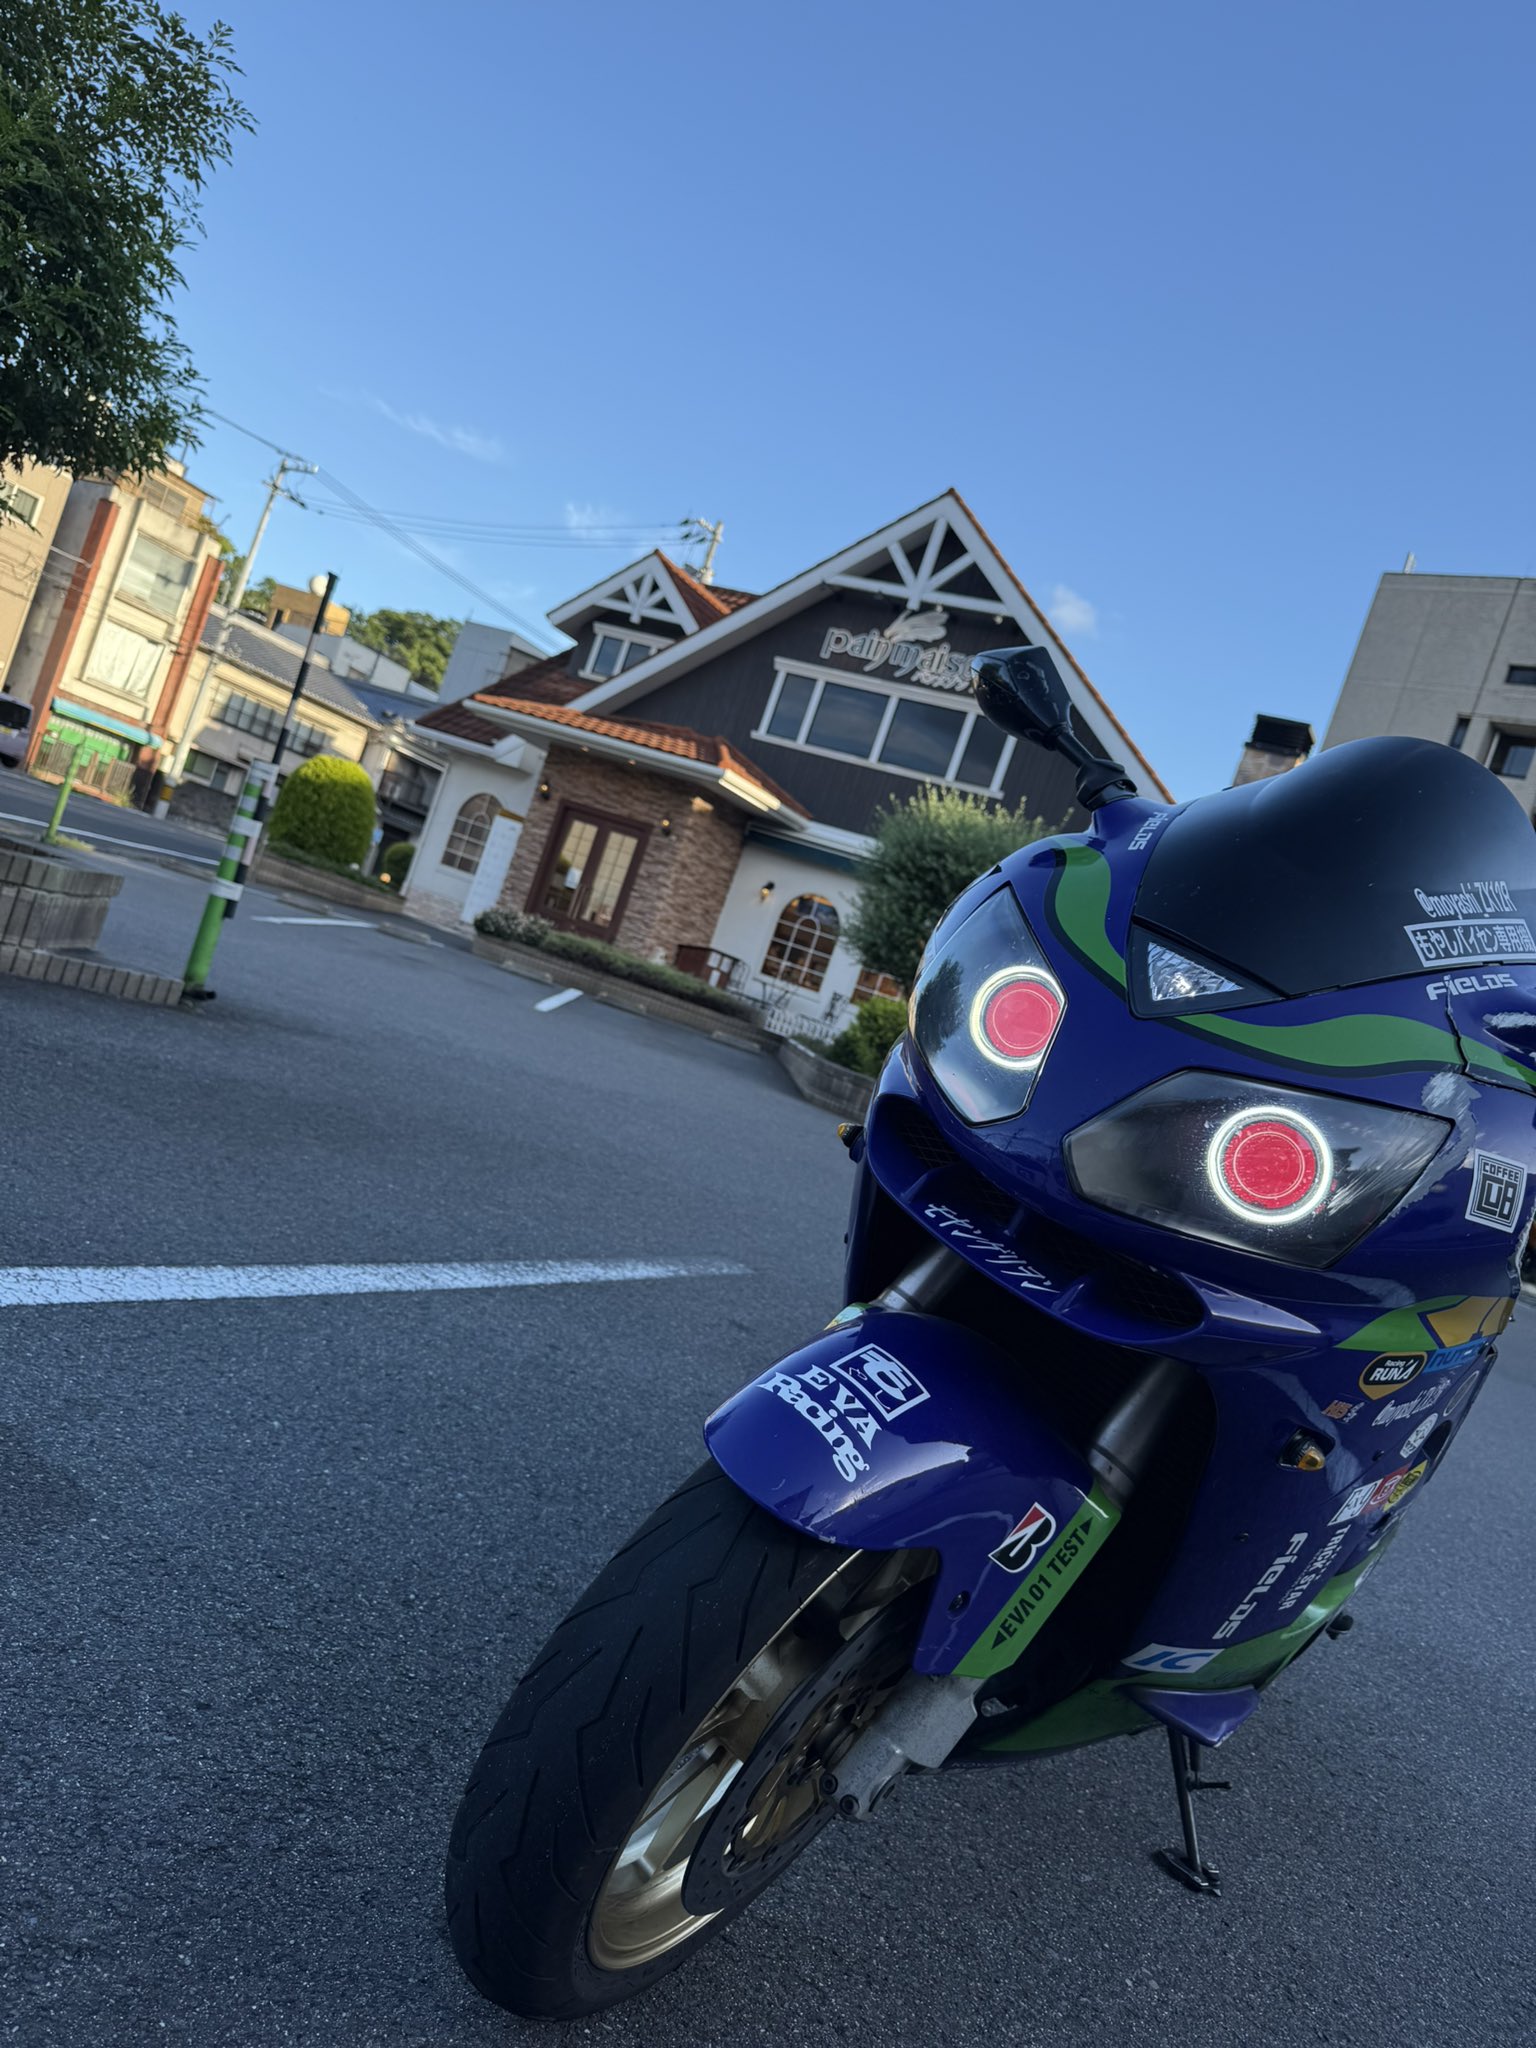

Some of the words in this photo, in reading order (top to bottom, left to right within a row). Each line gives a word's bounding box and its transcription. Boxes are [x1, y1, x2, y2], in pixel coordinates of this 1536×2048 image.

[1415, 925, 1536, 959] もやしパイセン専用機
[1482, 1161, 1520, 1183] COFFEE
[1384, 1359, 1407, 1368] Racing
[756, 1371, 870, 1483] Racing
[795, 1364, 883, 1450] EVA
[1309, 1523, 1352, 1572] TRICK
[999, 1597, 1037, 1639] EVA
[1028, 1573, 1053, 1602] 01
[1046, 1527, 1086, 1576] TEST
[1278, 1573, 1317, 1611] STAR
